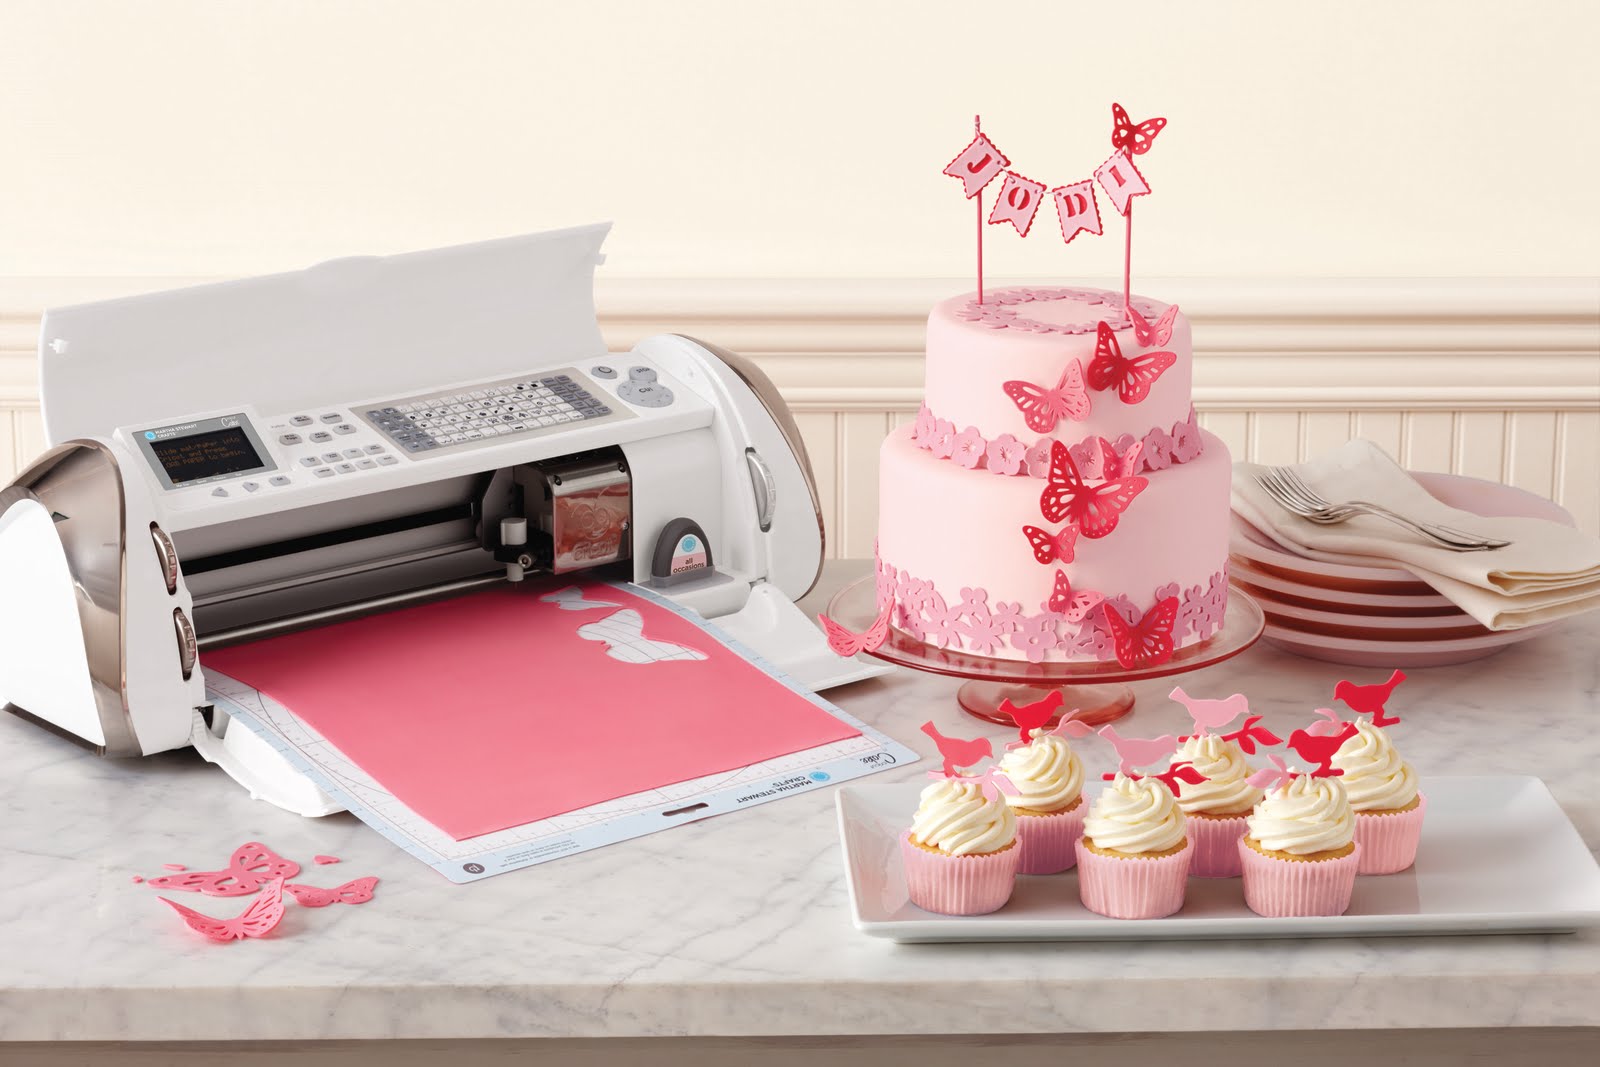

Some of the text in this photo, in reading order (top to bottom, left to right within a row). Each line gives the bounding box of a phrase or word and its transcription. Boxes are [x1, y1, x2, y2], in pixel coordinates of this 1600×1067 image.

[155, 423, 197, 435] MARTHA STEWART
[673, 561, 705, 574] occasions
[685, 557, 693, 565] all
[772, 775, 806, 788] CRAFTS
[736, 779, 813, 804] MARTHA STEWART
